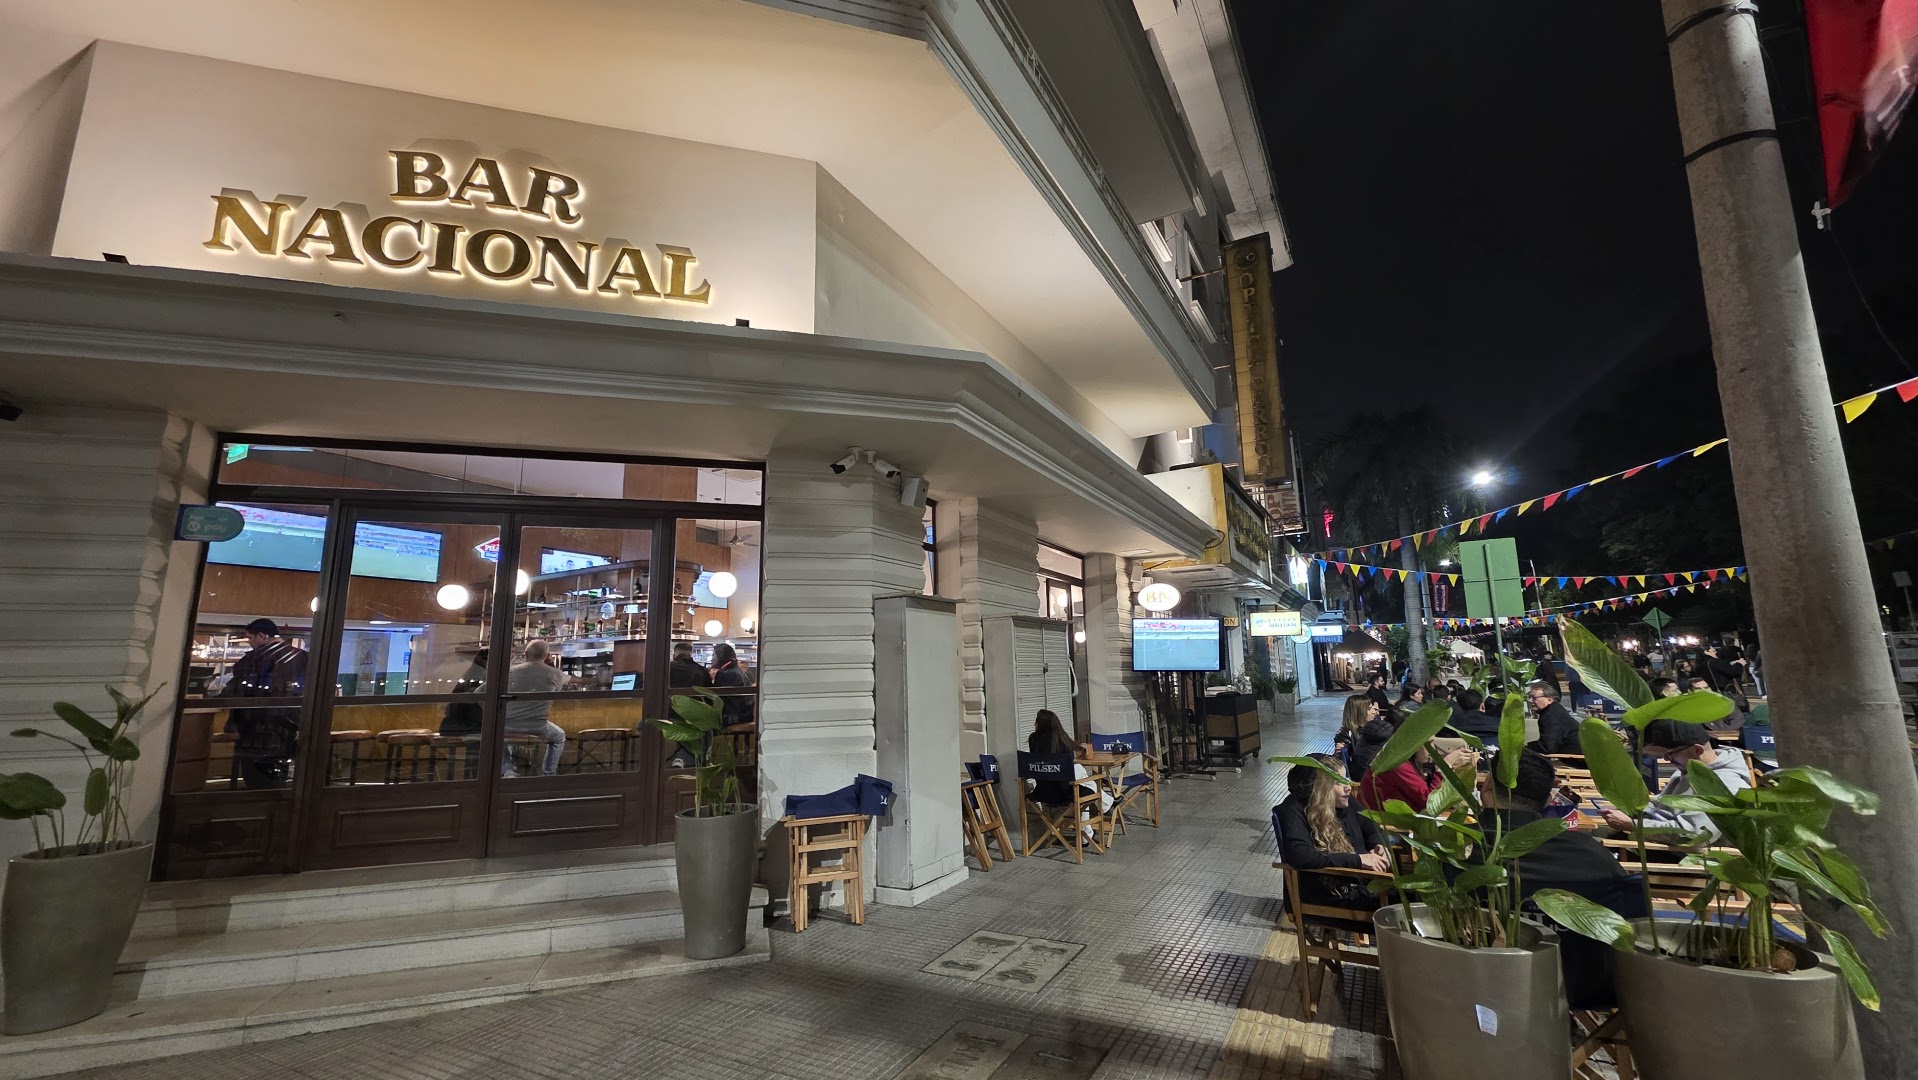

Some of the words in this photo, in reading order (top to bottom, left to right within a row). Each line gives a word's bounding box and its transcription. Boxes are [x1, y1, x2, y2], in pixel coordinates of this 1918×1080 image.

[388, 149, 582, 225] BAR
[202, 194, 712, 305] NACIONAL
[1029, 763, 1061, 773] PILSEN
